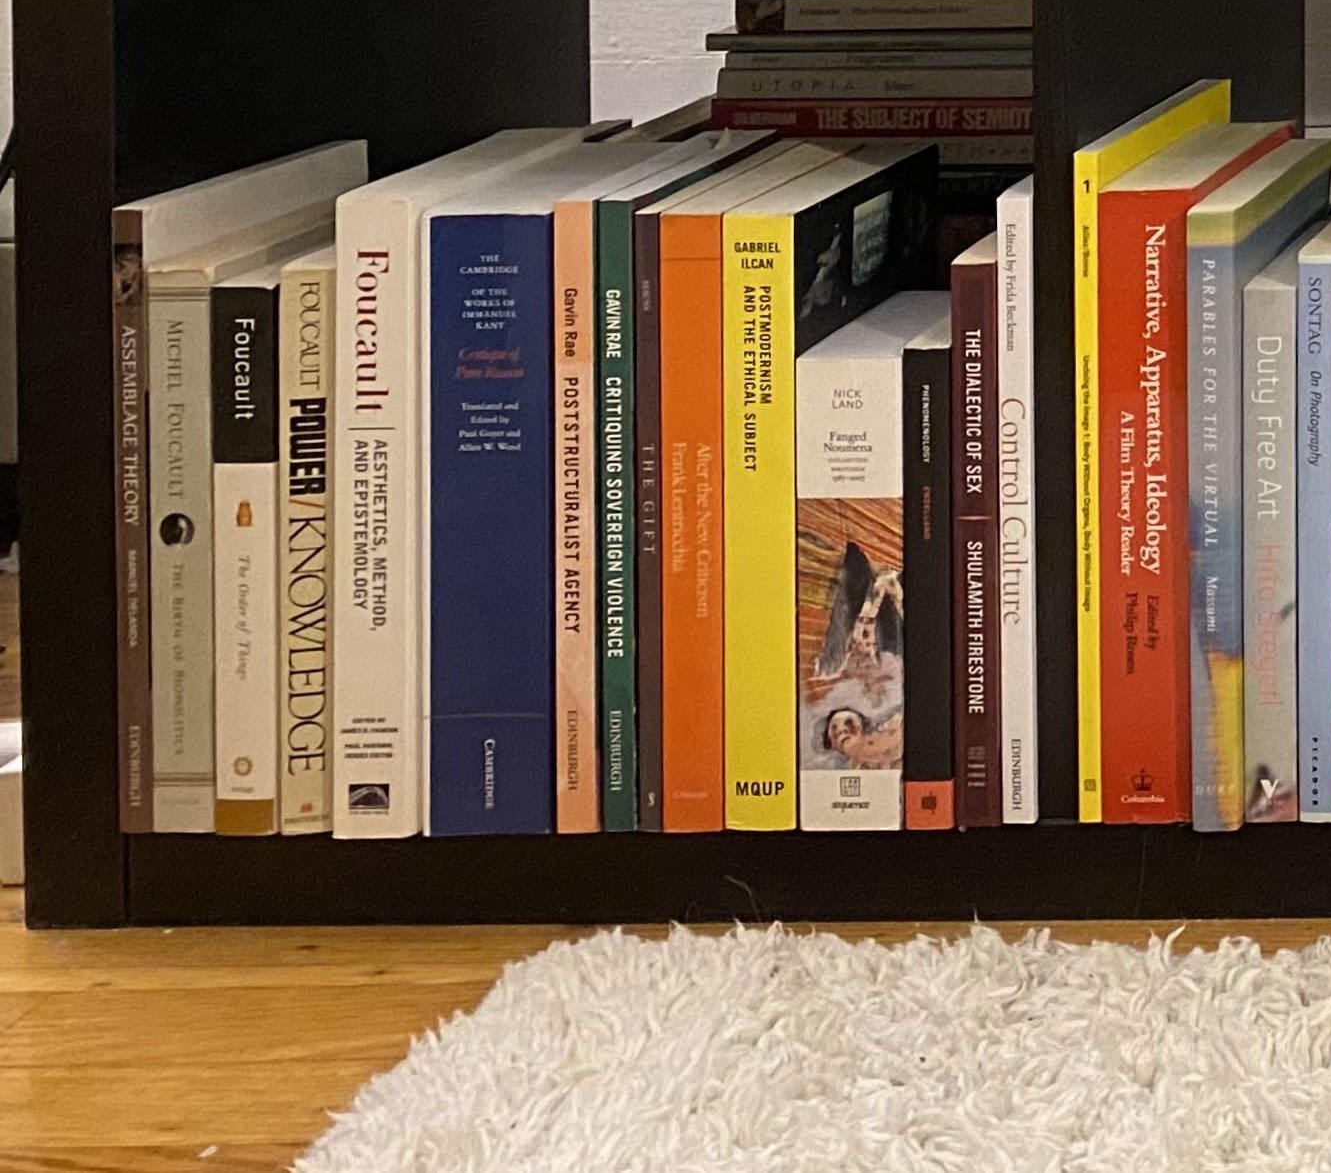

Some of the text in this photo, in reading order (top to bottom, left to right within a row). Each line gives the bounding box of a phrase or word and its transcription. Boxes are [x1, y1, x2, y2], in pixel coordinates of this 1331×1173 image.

[234, 319, 255, 420] Foucault
[357, 248, 390, 415] Foucault
[759, 286, 771, 404] POSTMODERNISM
[965, 329, 982, 493] THE DIALECTIC OF SEX
[1140, 225, 1166, 575] Narrative, Apparatus, Ideology
[564, 377, 580, 633] POSTSTRUCTURALIST AGENCY
[1001, 398, 1028, 624] Control Culture
[1251, 336, 1282, 519] Duty Free Art
[605, 377, 623, 658] CRITIQUING SOVEREIGN VIOLENCE
[288, 515, 326, 775] KNOWLEDGE
[967, 541, 984, 714] SHULAMITH FIRESTONE
[736, 782, 784, 796] MQUP
